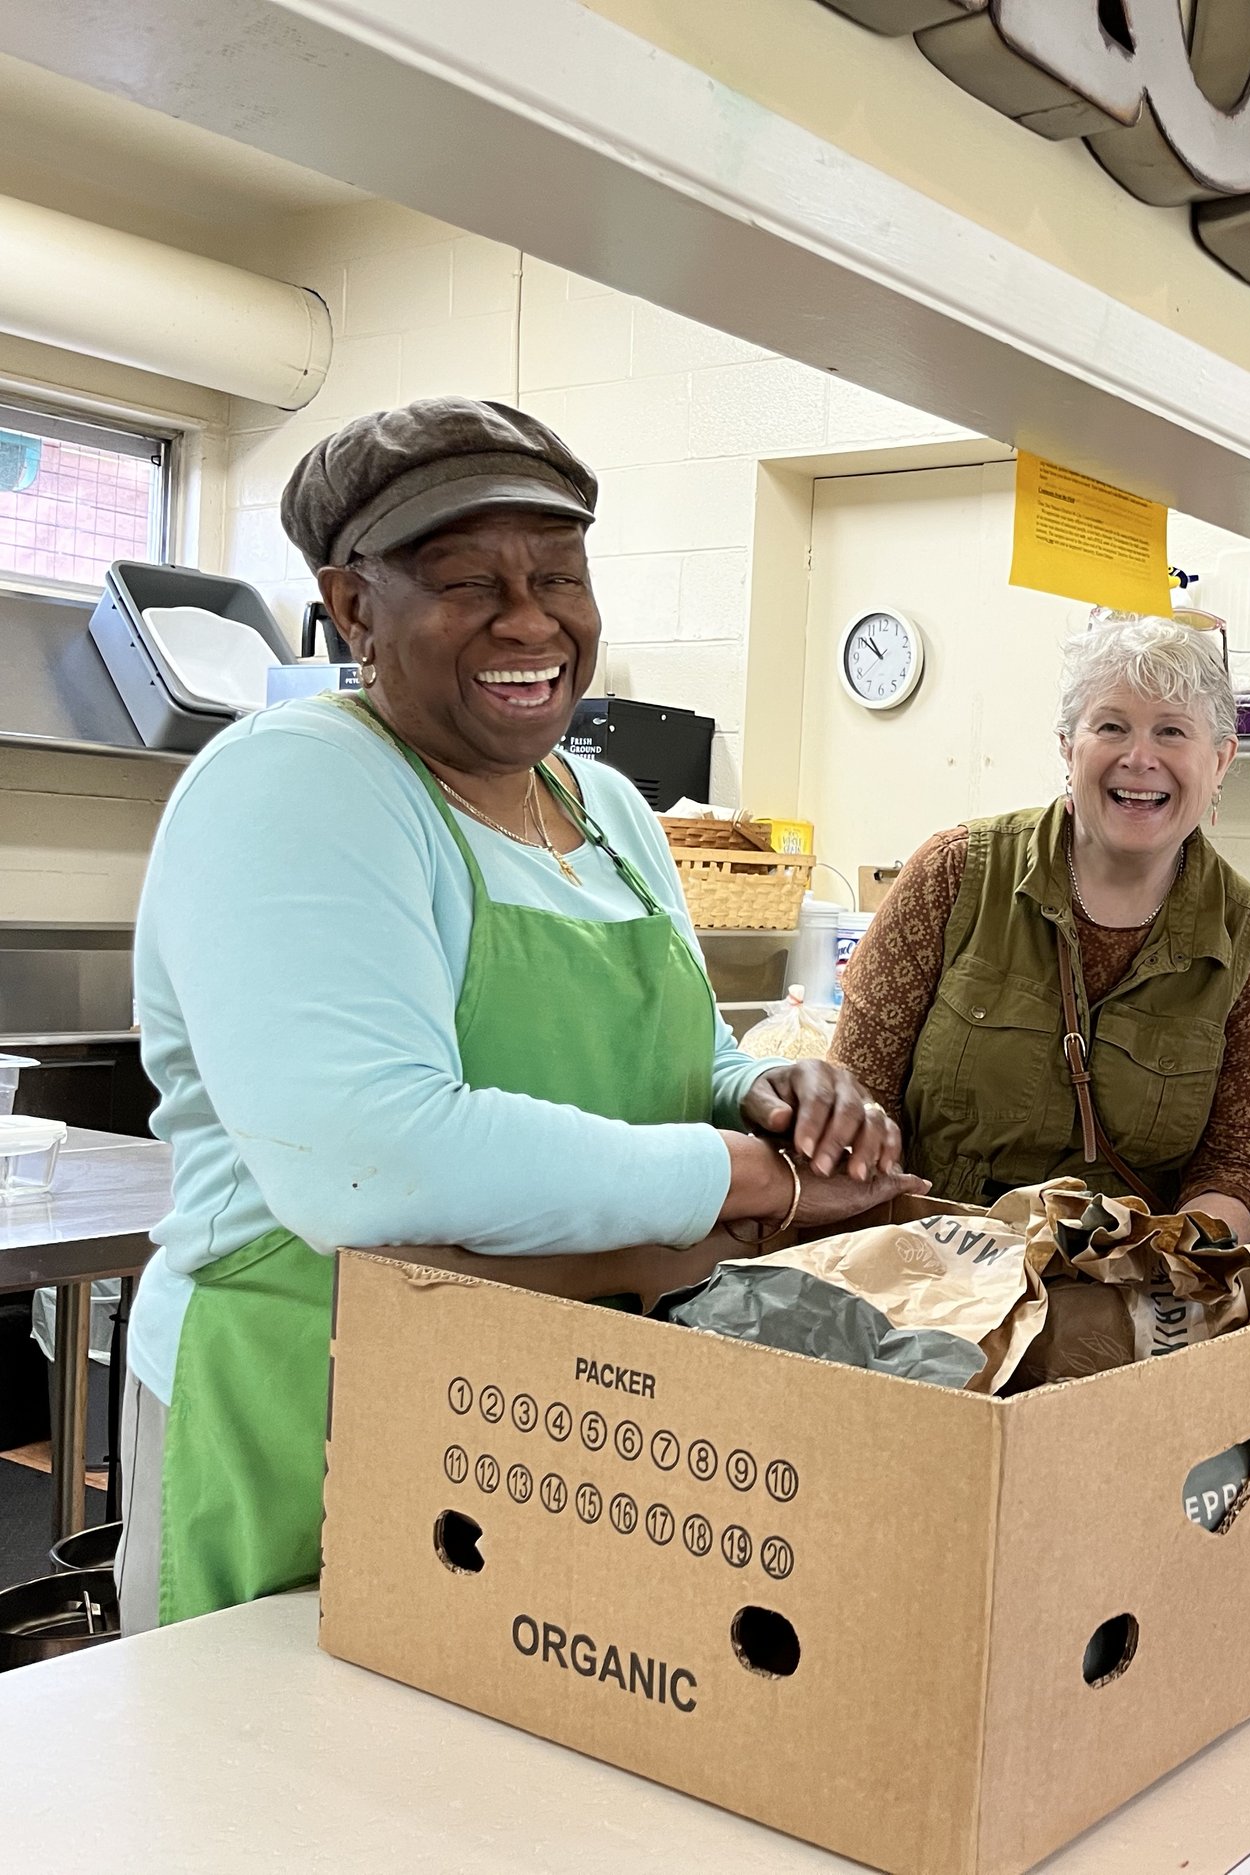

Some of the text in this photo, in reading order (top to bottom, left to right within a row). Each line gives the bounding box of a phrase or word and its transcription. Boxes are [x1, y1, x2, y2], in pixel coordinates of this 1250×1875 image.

[868, 624, 875, 636] 11
[879, 619, 889, 632] 12
[894, 624, 898, 636] 1
[902, 636, 909, 648] 2
[853, 652, 860, 664] 9
[906, 651, 911, 664] 3
[857, 668, 863, 680] 8
[900, 667, 906, 680] 4
[866, 680, 872, 692] 7
[878, 684, 884, 696] 6
[890, 680, 897, 692] 5
[570, 737, 593, 746] FRESH
[570, 744, 602, 753] GROUND
[575, 1357, 655, 1399] PACKER
[448, 1450, 788, 1575] 11 12 13 14 15 16 17 18 19 20
[512, 1613, 698, 1713] ORGANIC
